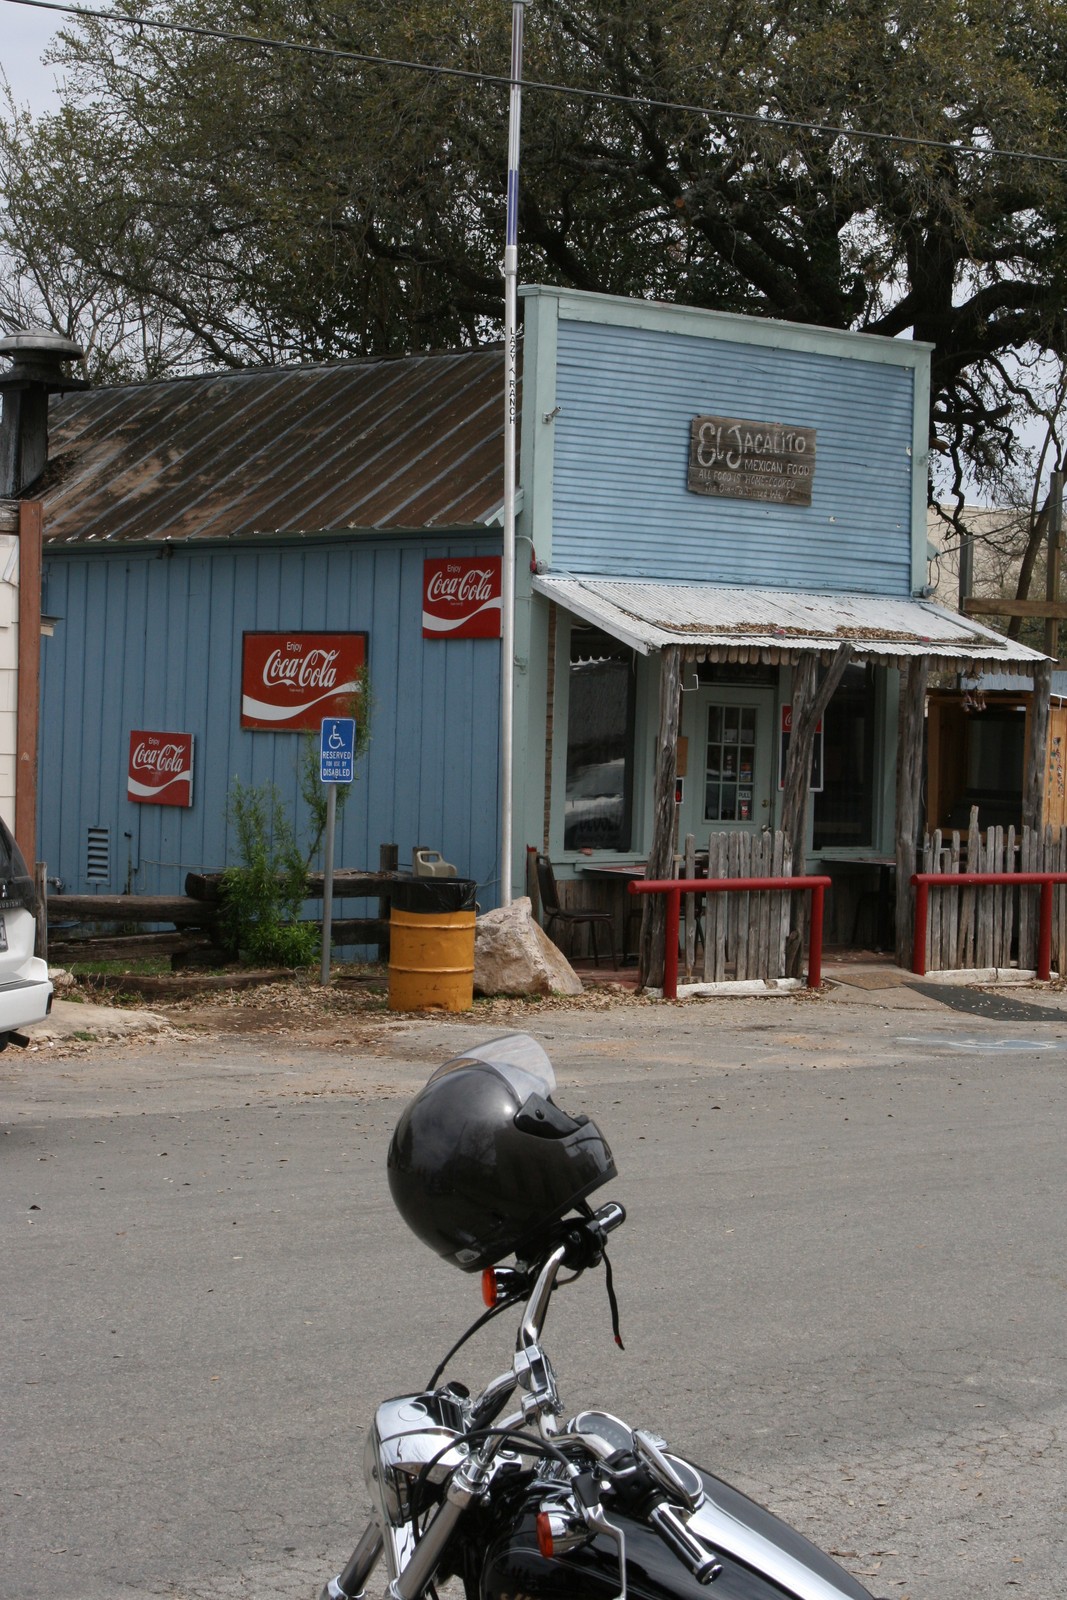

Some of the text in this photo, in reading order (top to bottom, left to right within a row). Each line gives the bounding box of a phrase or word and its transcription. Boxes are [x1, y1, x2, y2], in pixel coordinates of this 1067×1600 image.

[744, 459, 809, 476] MEXICAN FOOD
[699, 469, 711, 480] ALL
[713, 471, 732, 482] FOOD
[447, 564, 462, 574] Enjoy
[427, 569, 496, 602] Coca-Cola
[286, 641, 303, 653] Enjoy
[262, 649, 341, 688] Coca-Cola
[148, 737, 160, 745] Enjoy
[132, 743, 185, 772] Coca-Cola
[322, 751, 352, 760] RESERVED
[322, 768, 351, 777] DISABLED
